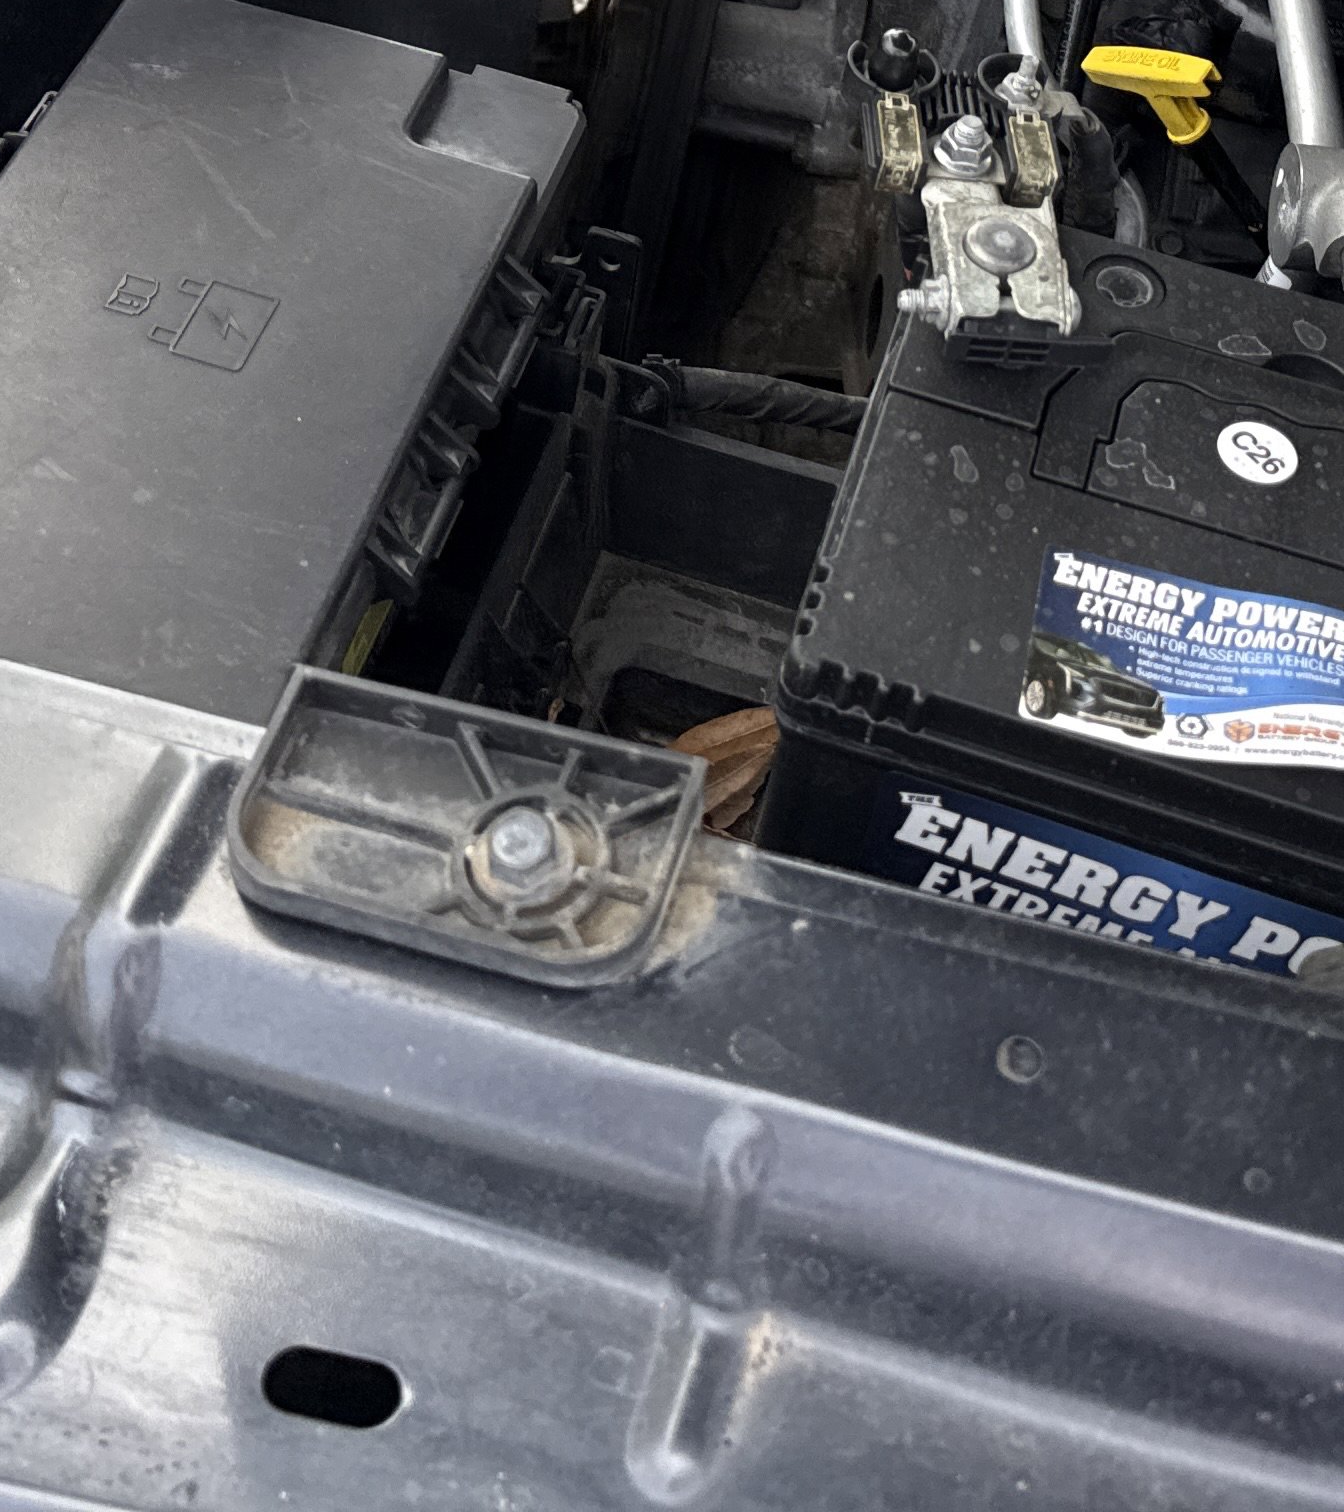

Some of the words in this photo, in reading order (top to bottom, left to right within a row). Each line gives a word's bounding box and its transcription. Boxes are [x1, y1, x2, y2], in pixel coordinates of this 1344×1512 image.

[1158, 54, 1182, 72] OIL
[1231, 430, 1286, 475] C26
[1053, 558, 1206, 618] ENERGY
[1076, 591, 1185, 637] EXTREME
[1080, 616, 1104, 634] #1
[1106, 622, 1158, 648] DESIGN
[1160, 636, 1189, 656] FOR
[1190, 644, 1274, 667] PASSENGER
[1135, 669, 1174, 686] Superior
[1176, 676, 1215, 694] cranking
[1137, 646, 1181, 664] High-tech
[1295, 671, 1341, 686] withstand
[1137, 657, 1172, 672] extreme
[1175, 663, 1234, 684] temperatures
[894, 803, 1230, 941] ENERGY
